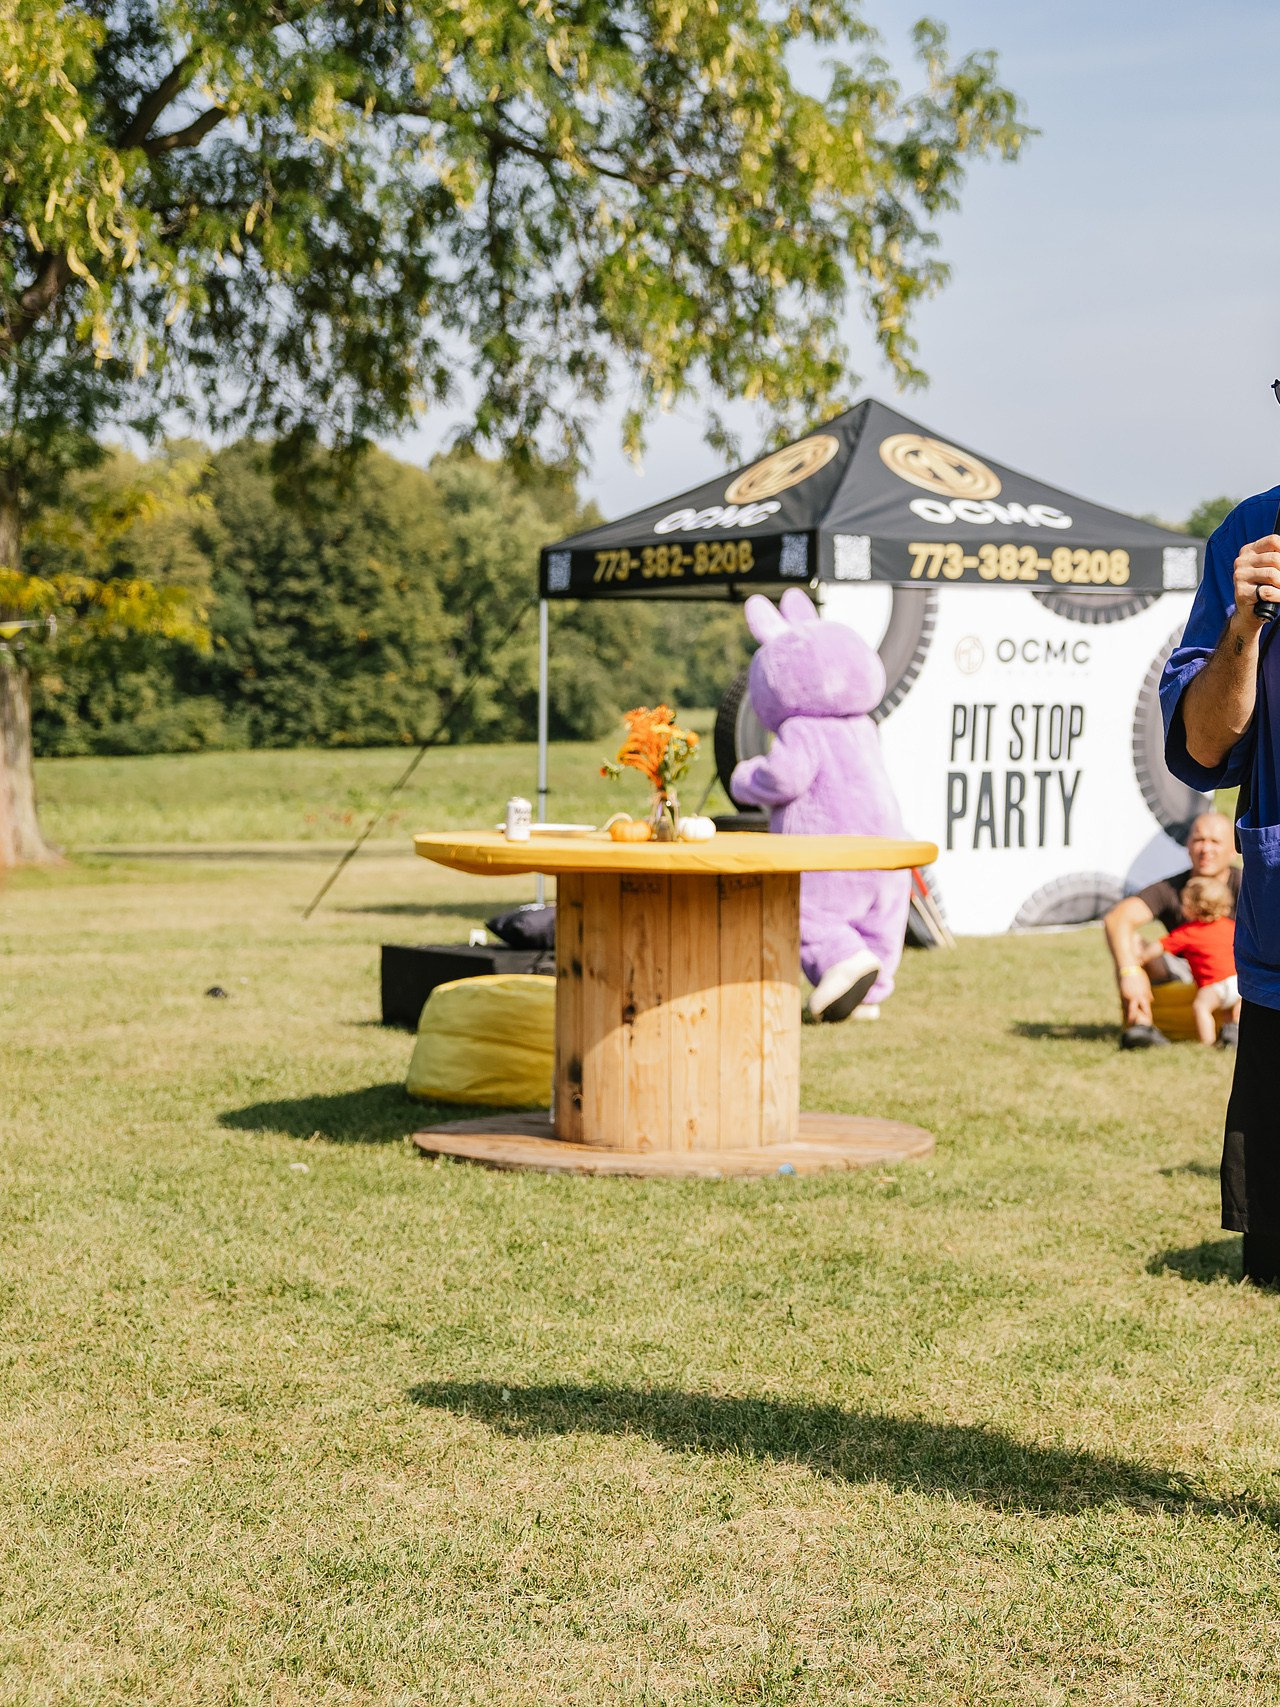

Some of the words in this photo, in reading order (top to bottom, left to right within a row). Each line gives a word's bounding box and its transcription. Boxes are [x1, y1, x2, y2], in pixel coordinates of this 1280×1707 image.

[909, 498, 1073, 530] OCMC
[593, 539, 755, 584] 773-382-8208
[908, 542, 1130, 585] 773-382-8208
[997, 639, 1091, 664] OCMC
[950, 704, 997, 762] PIT
[1009, 704, 1084, 761] STOP
[946, 770, 1081, 850] PARTY
